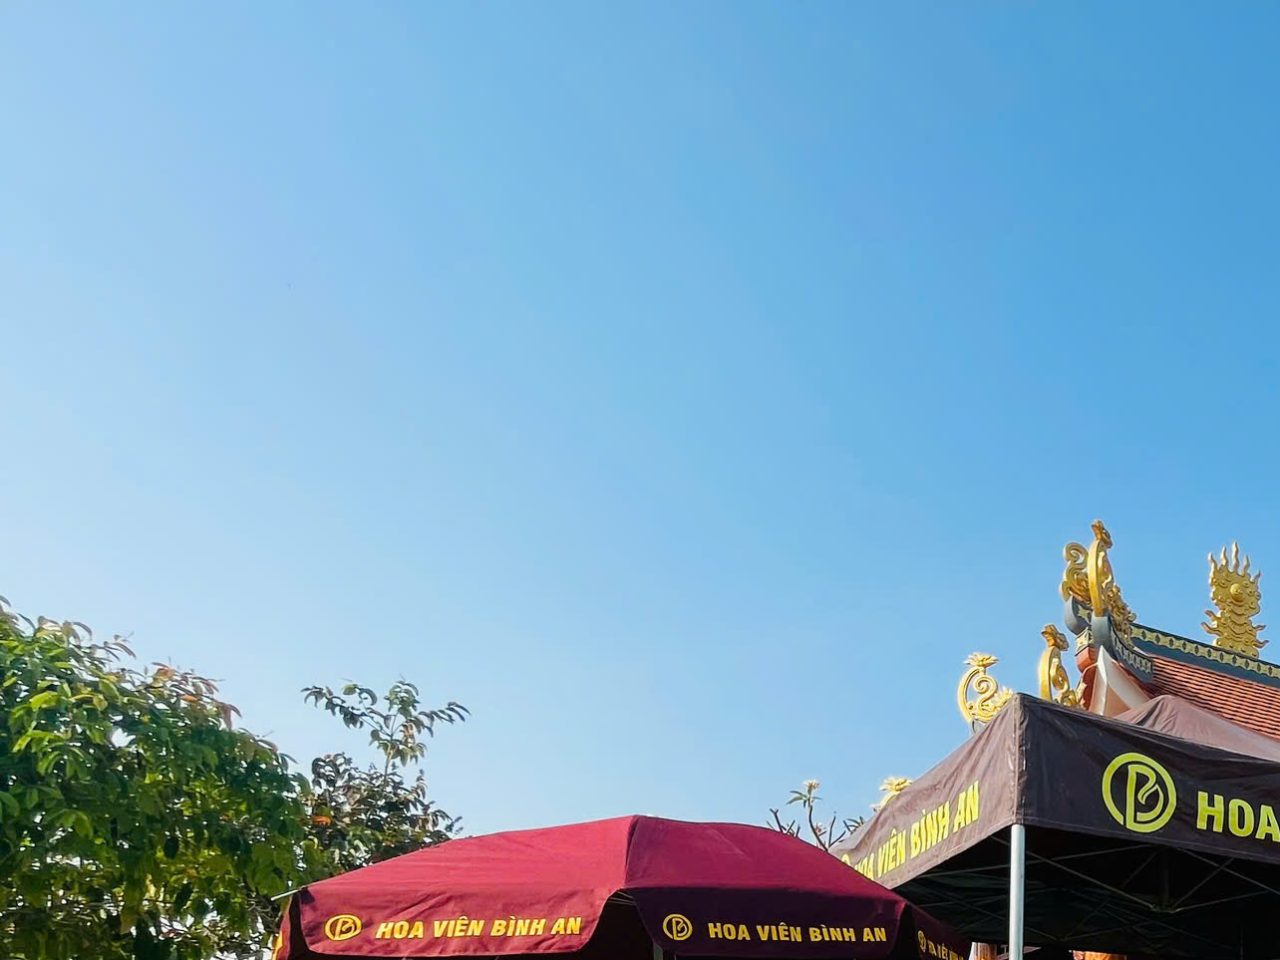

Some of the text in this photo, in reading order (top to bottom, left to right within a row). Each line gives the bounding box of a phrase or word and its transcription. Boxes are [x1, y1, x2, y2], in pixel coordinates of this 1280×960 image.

[877, 828, 906, 878] VIÊN
[910, 808, 950, 859] BÌNH
[953, 780, 979, 833] AN
[375, 920, 424, 939] HOA
[433, 916, 485, 938] VIÊN
[490, 916, 546, 937] BÌNH
[551, 917, 582, 935] AN
[708, 923, 751, 941] HOA
[756, 922, 803, 942] VIÊN
[809, 925, 857, 942] BÌNH
[862, 927, 888, 942] AN
